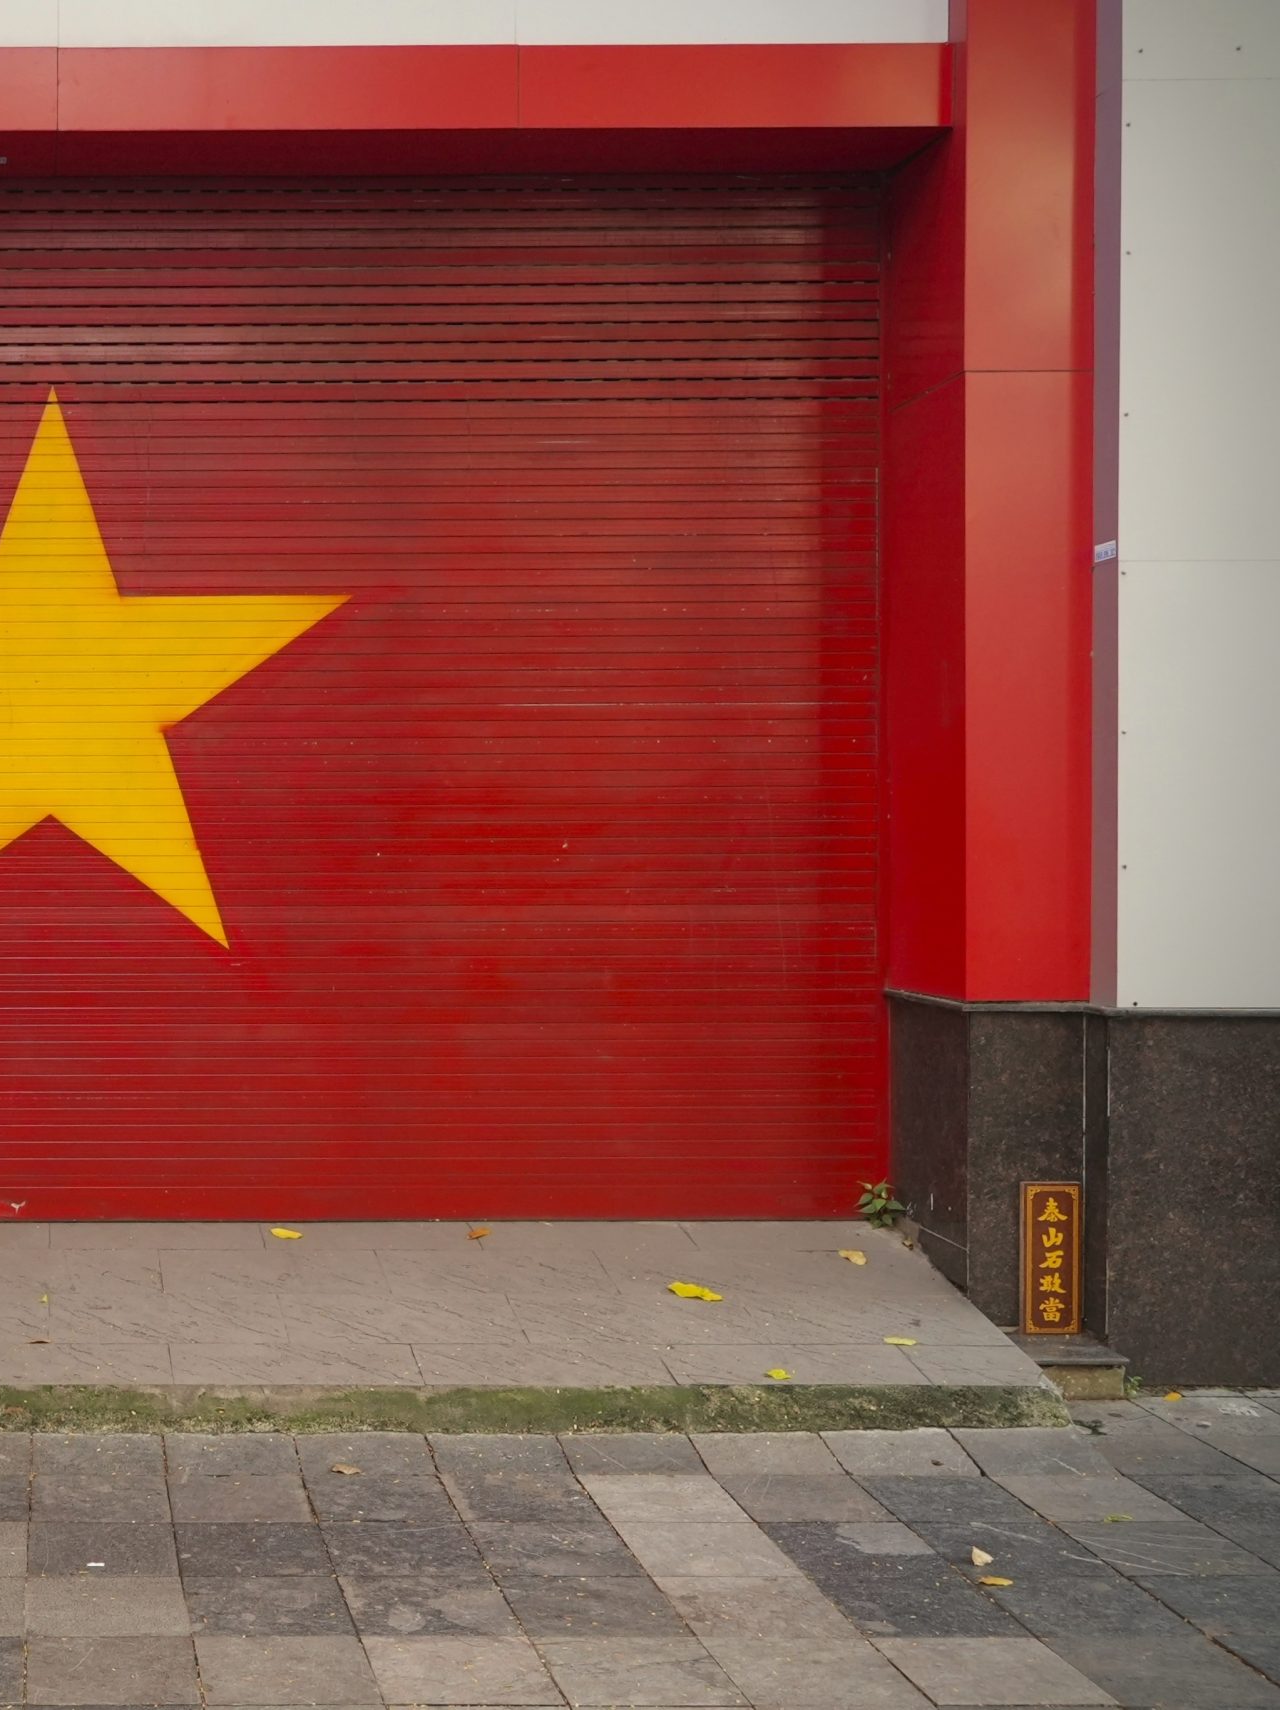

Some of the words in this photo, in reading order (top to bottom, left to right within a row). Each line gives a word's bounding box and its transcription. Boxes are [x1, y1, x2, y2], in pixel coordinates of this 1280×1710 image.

[1037, 1197, 1068, 1322] 泰山石敢當
